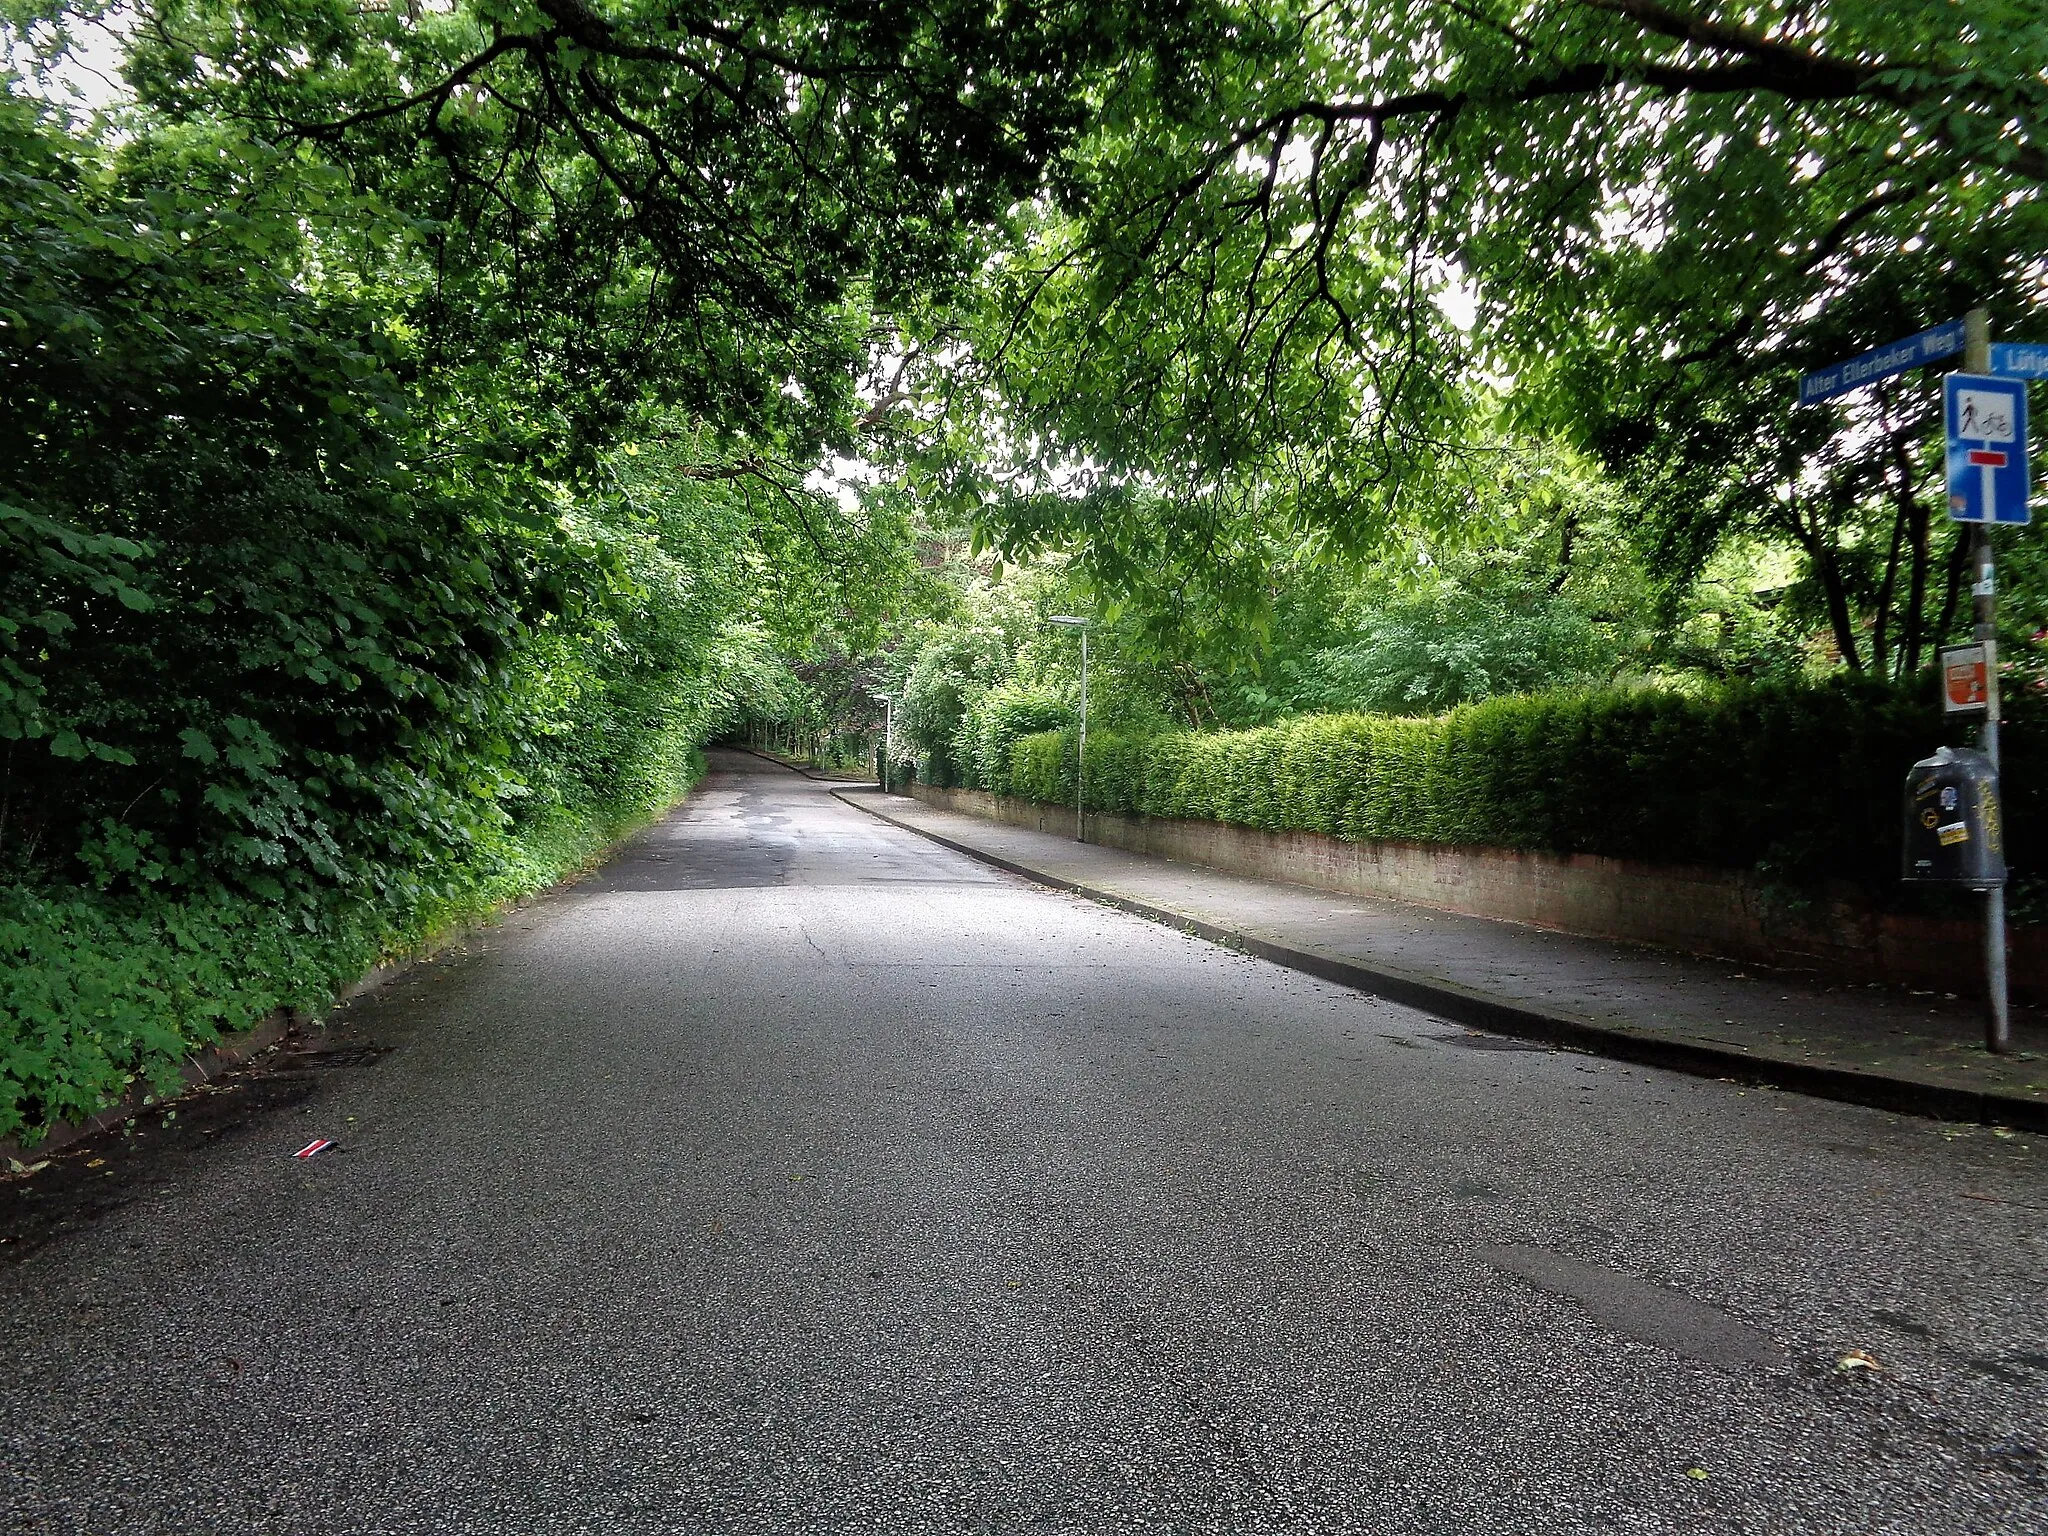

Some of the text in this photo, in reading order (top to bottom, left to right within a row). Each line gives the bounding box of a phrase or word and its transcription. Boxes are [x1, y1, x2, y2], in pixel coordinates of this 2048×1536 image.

[1806, 332, 1955, 397] Alter Ellerbeker Weg
